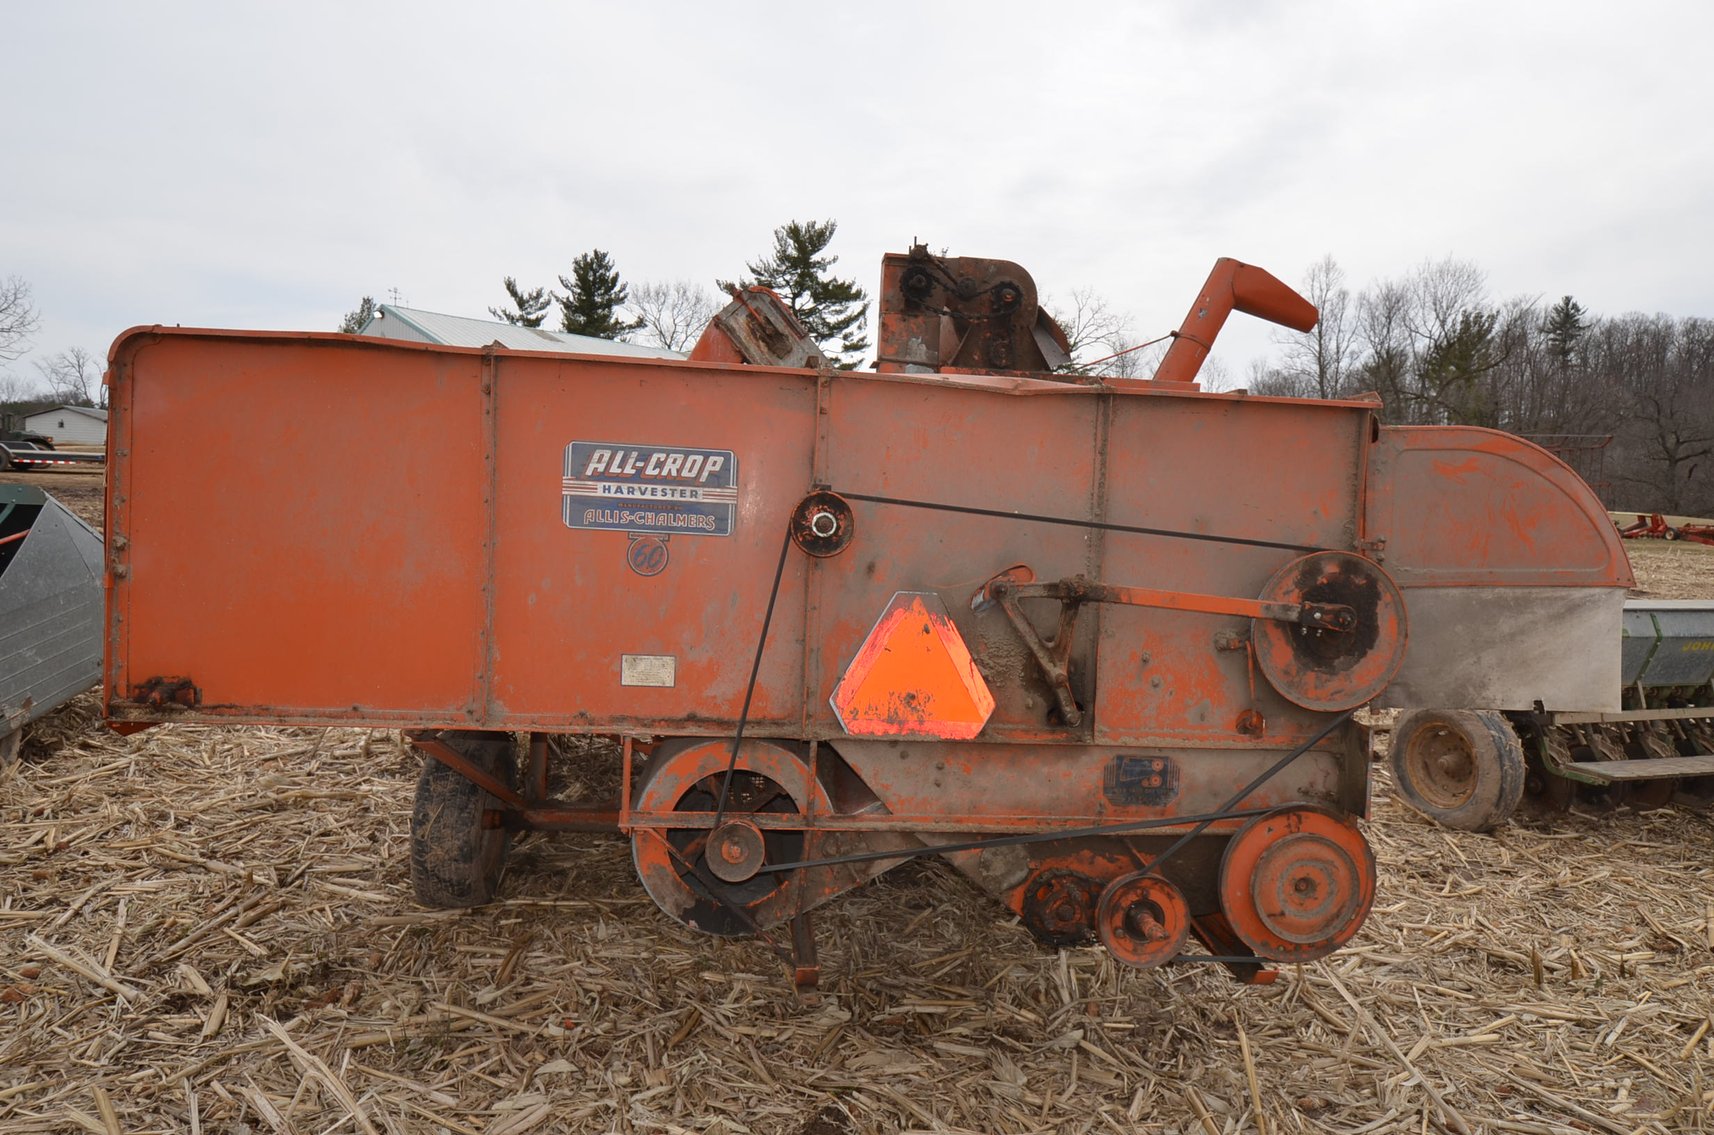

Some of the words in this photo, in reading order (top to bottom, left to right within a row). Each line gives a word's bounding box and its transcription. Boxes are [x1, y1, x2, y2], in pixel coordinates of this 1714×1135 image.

[585, 449, 725, 482] ALL-CROP
[602, 484, 699, 499] HARVESTER
[583, 508, 716, 531] ALLIS-CHALMERS
[632, 543, 664, 569] 60
[1681, 640, 1714, 653] JOH
